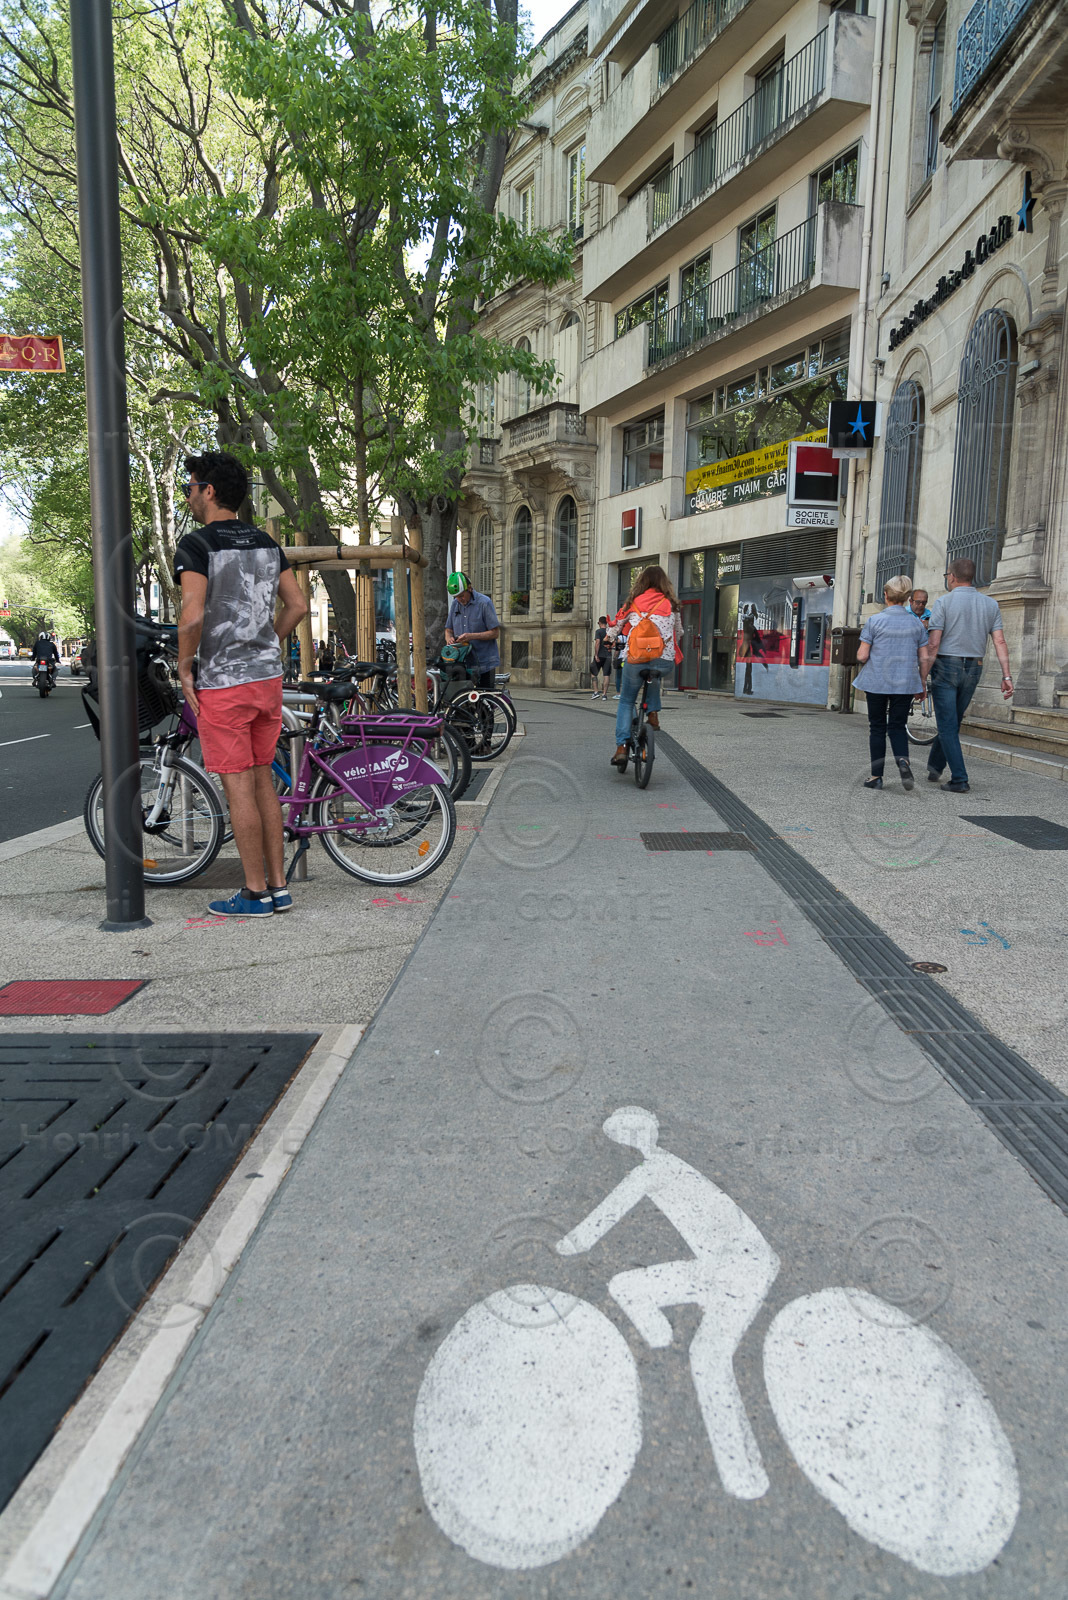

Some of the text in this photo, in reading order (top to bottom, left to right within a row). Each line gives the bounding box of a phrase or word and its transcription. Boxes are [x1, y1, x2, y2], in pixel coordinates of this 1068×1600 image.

[701, 456, 755, 479] www.fnaim30.com
[690, 472, 787, 508] CHAMBRE FNAIM GAR
